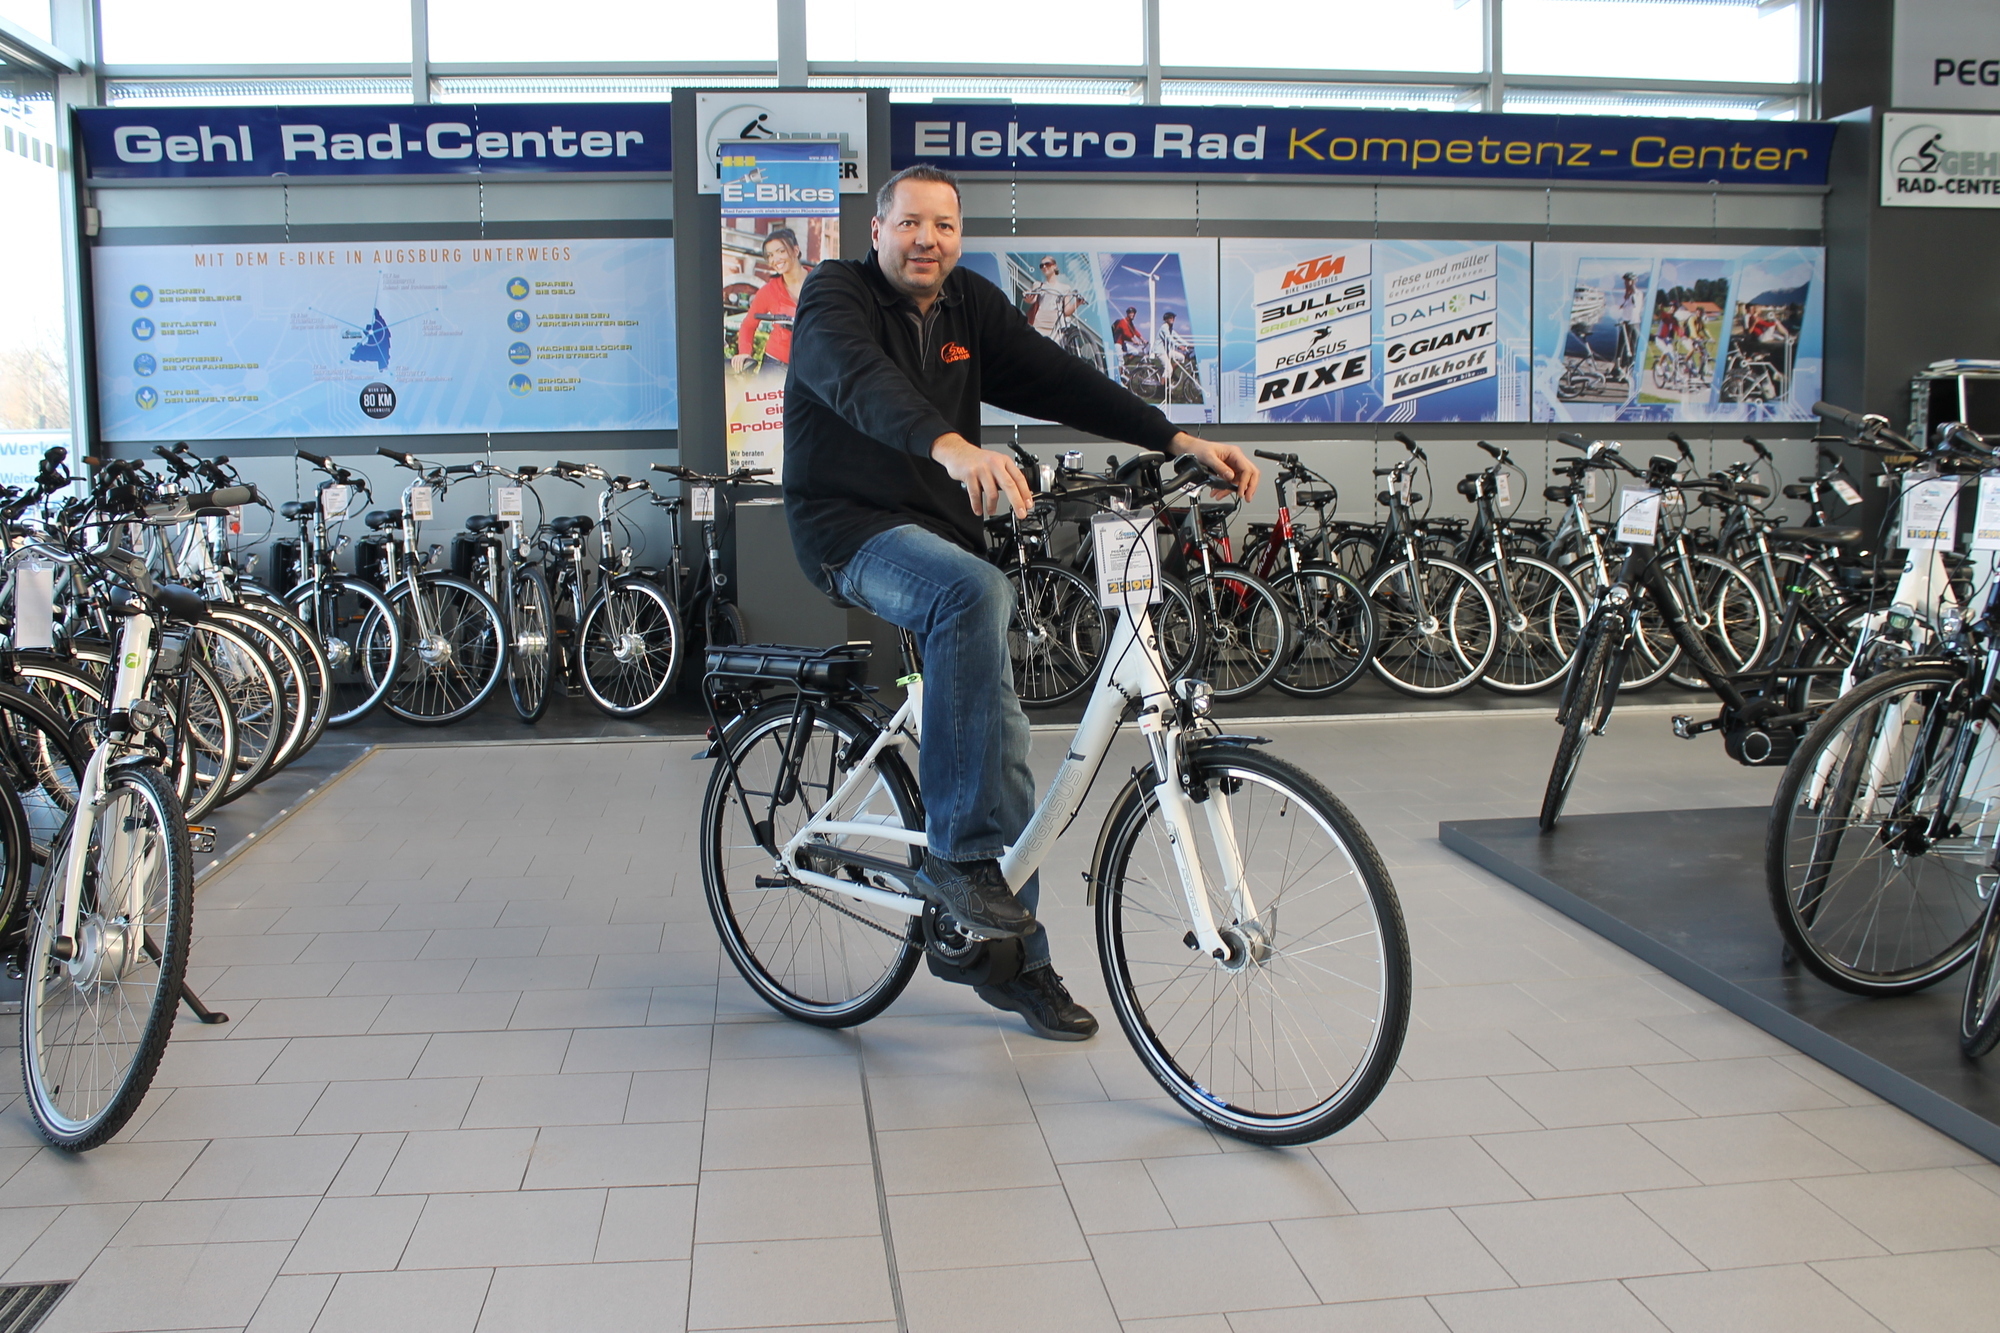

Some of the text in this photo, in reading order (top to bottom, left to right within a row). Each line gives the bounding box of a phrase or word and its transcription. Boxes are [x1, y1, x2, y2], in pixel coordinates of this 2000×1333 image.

[113, 122, 644, 163] Gehl Rad-Center
[914, 121, 1137, 159] Elektro
[1153, 124, 1266, 160] Rad
[1940, 151, 2000, 176] GEH
[723, 183, 835, 202] E-Bikes
[194, 246, 572, 267] MIT DEM E-BIKE IN AUGSBURG UNTERWEGS
[1281, 254, 1346, 289] KTM
[1392, 253, 1490, 289] riese und müller
[1285, 275, 1339, 295] BIKE INDUSTRIES
[1261, 284, 1366, 323] BULLS
[1260, 315, 1310, 335] GREEN
[1408, 321, 1493, 356] GIANT
[1275, 339, 1347, 369] PEGASUS
[1394, 350, 1487, 389] Kalkhoff
[1258, 355, 1367, 404] RIXE
[363, 393, 392, 407] 80 KM
[745, 389, 785, 403] Lust
[741, 460, 756, 468] gern.
[1015, 764, 1083, 866] PEGASUS
